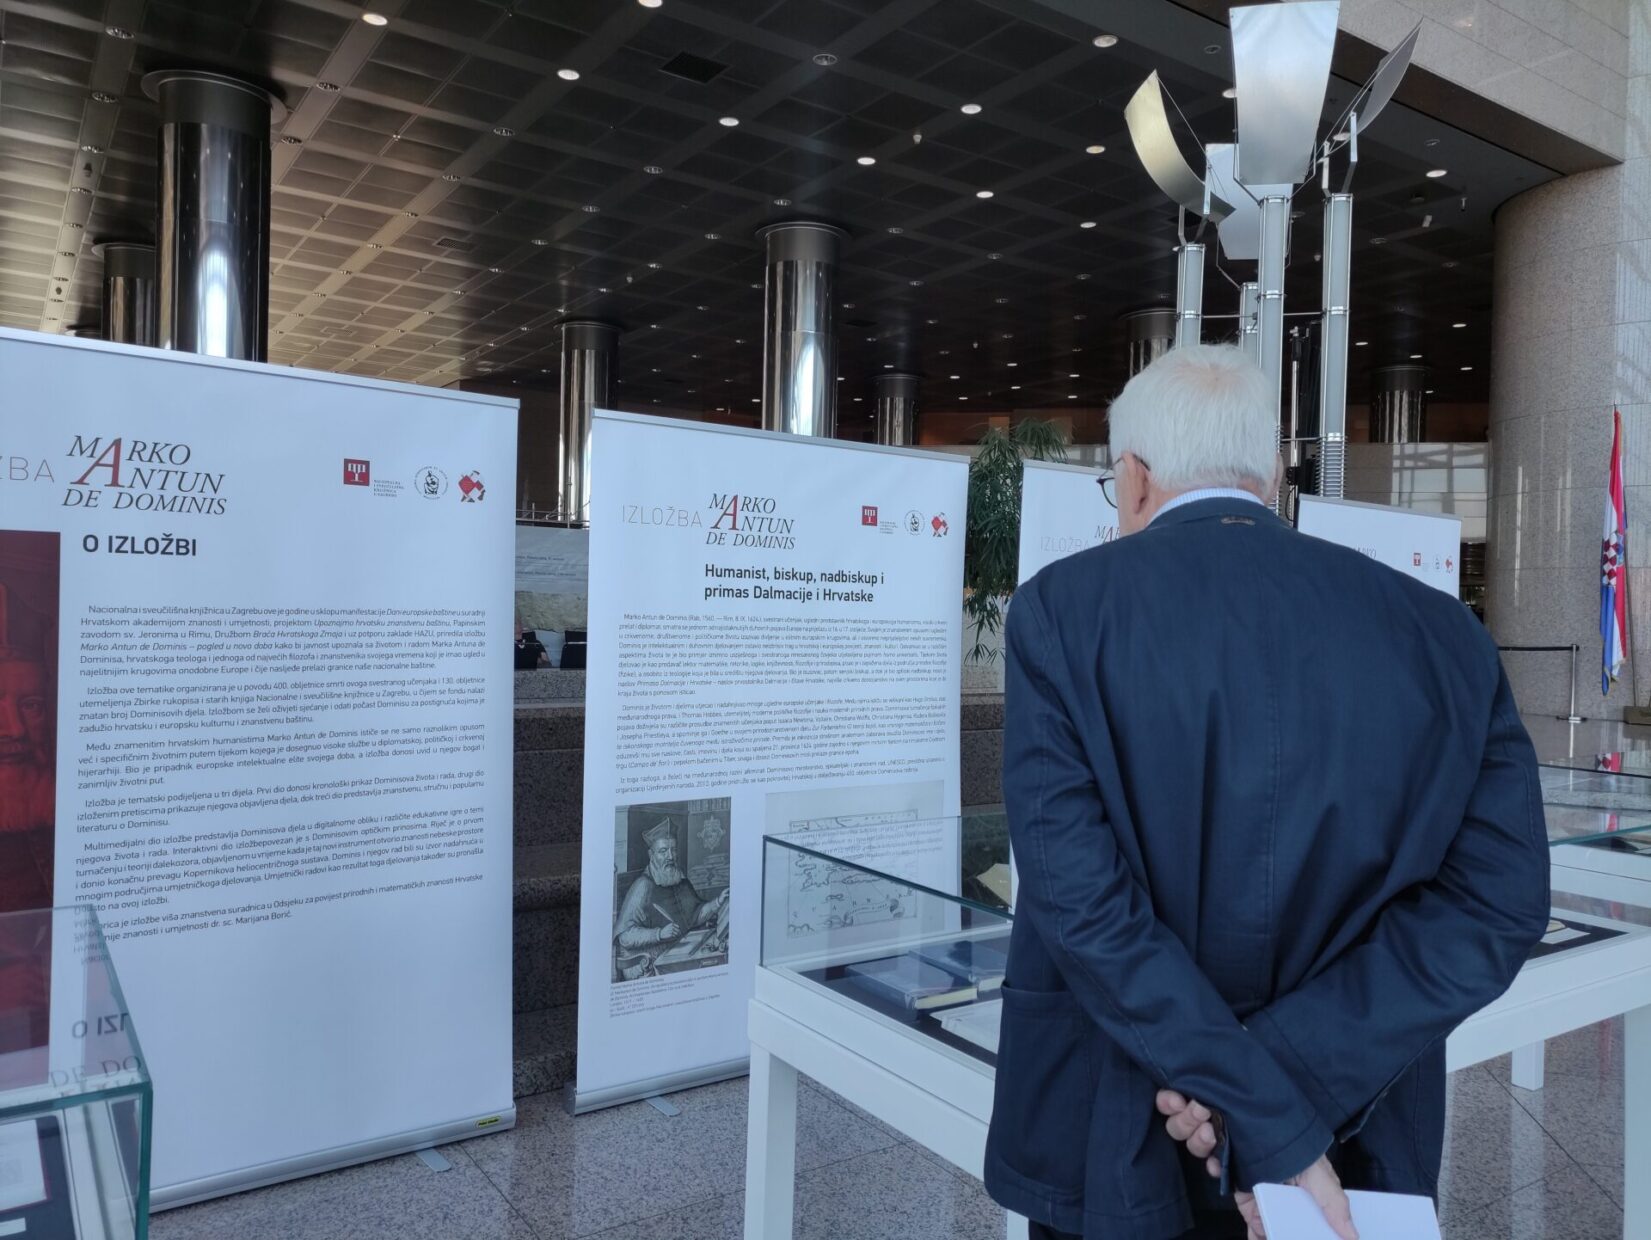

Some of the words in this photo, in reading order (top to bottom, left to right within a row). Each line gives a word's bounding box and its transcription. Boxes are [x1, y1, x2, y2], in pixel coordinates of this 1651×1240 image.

[0, 456, 55, 483] BA
[61, 488, 101, 508] DE
[113, 491, 227, 515] DOMINIS
[622, 504, 702, 528] IZLOŽBA
[82, 534, 99, 553] O
[108, 533, 197, 556] IZLOŽBI
[706, 531, 727, 545] DE
[733, 533, 796, 550] DOMINIS
[705, 563, 770, 581] Humanist,
[774, 566, 817, 584] biskup,
[820, 567, 878, 587] nadbiskup
[704, 584, 749, 600] primas
[753, 585, 813, 603] Dalmacije
[823, 588, 874, 602] Hrvatske
[88, 605, 137, 614] Nacionalna
[142, 606, 188, 614] sveučilišna
[189, 606, 224, 616] knjižnica
[231, 606, 262, 616] Zagrebu
[80, 617, 129, 626] Hrvatskom
[132, 618, 185, 628] akademijom
[188, 618, 221, 626] znanosti
[80, 630, 120, 638] zavodom
[139, 630, 178, 638] Jeronima
[214, 630, 250, 638] Družbom
[253, 630, 275, 638] Braća
[80, 642, 108, 650] Marko
[111, 642, 137, 650] Antun
[152, 642, 186, 650] Dominis
[196, 642, 224, 652] pogled
[126, 654, 174, 664] hrvatskoga
[176, 654, 206, 664] teologa
[212, 653, 244, 663] jednoga
[256, 653, 287, 663] najvećih
[80, 667, 128, 677] najelitnijim
[130, 666, 176, 676] krugovima
[178, 666, 218, 674] onodobne
[221, 665, 248, 675] Europe
[87, 686, 117, 695] Izložba
[137, 685, 174, 694] tematike
[176, 684, 226, 694] organizirana
[244, 682, 271, 692] povodu
[79, 698, 131, 708] utemeljenja
[134, 697, 160, 706] Zbirke
[162, 696, 199, 706] rukopisa
[205, 695, 228, 703] starih
[79, 711, 108, 720] znatan
[130, 708, 182, 718] Dominisovih
[208, 706, 244, 715] Izložbom
[79, 723, 112, 732] zadužio
[114, 722, 152, 731] hrvatsku
[159, 720, 198, 730] europsku
[201, 719, 234, 727] kulturnu
[241, 716, 284, 726] znanstvenu
[114, 740, 164, 750] znamenitim
[168, 737, 209, 747] hrvatskim
[212, 735, 264, 745] humanistima
[101, 753, 149, 764] specifičnim
[152, 751, 187, 760] životnim
[189, 749, 215, 760] putem
[249, 746, 275, 756] kojega
[153, 762, 192, 774] pripadnik
[196, 759, 233, 770] europske
[236, 756, 285, 767] intelektualne
[78, 779, 117, 789] zanimljiv
[119, 777, 147, 786] životni
[85, 798, 115, 808] Izložba
[128, 794, 165, 804] tematski
[167, 791, 212, 803] podijeljena
[77, 810, 119, 820] izloženim
[120, 807, 165, 819] pretiscima
[167, 803, 205, 815] prikazuje
[206, 801, 238, 812] njegova
[239, 798, 278, 809] objavljena
[77, 823, 117, 833] literaturu
[84, 838, 145, 851] Multimedijalni
[163, 834, 191, 844] izložbe
[194, 829, 238, 843] predstavlja
[241, 826, 285, 836] Dominisova
[76, 855, 111, 865] njegova
[114, 851, 140, 860] života
[172, 843, 218, 855] Interaktivni
[76, 865, 122, 877] tumačenju
[201, 853, 250, 865] objavljenom
[80, 879, 105, 888] donio
[107, 875, 144, 886] konačnu
[146, 872, 181, 883] prevagu
[183, 866, 234, 878] Kopernikova
[75, 890, 112, 901] mnogim
[114, 886, 162, 899] područjima
[164, 879, 219, 892] umjetničkoga
[131, 915, 159, 926] izložbe
[181, 908, 226, 920] znanstvena
[228, 902, 265, 914] suradnica
[123, 927, 158, 939] znanosti
[165, 920, 208, 933] umjetnosti
[235, 914, 269, 924] Marijana
